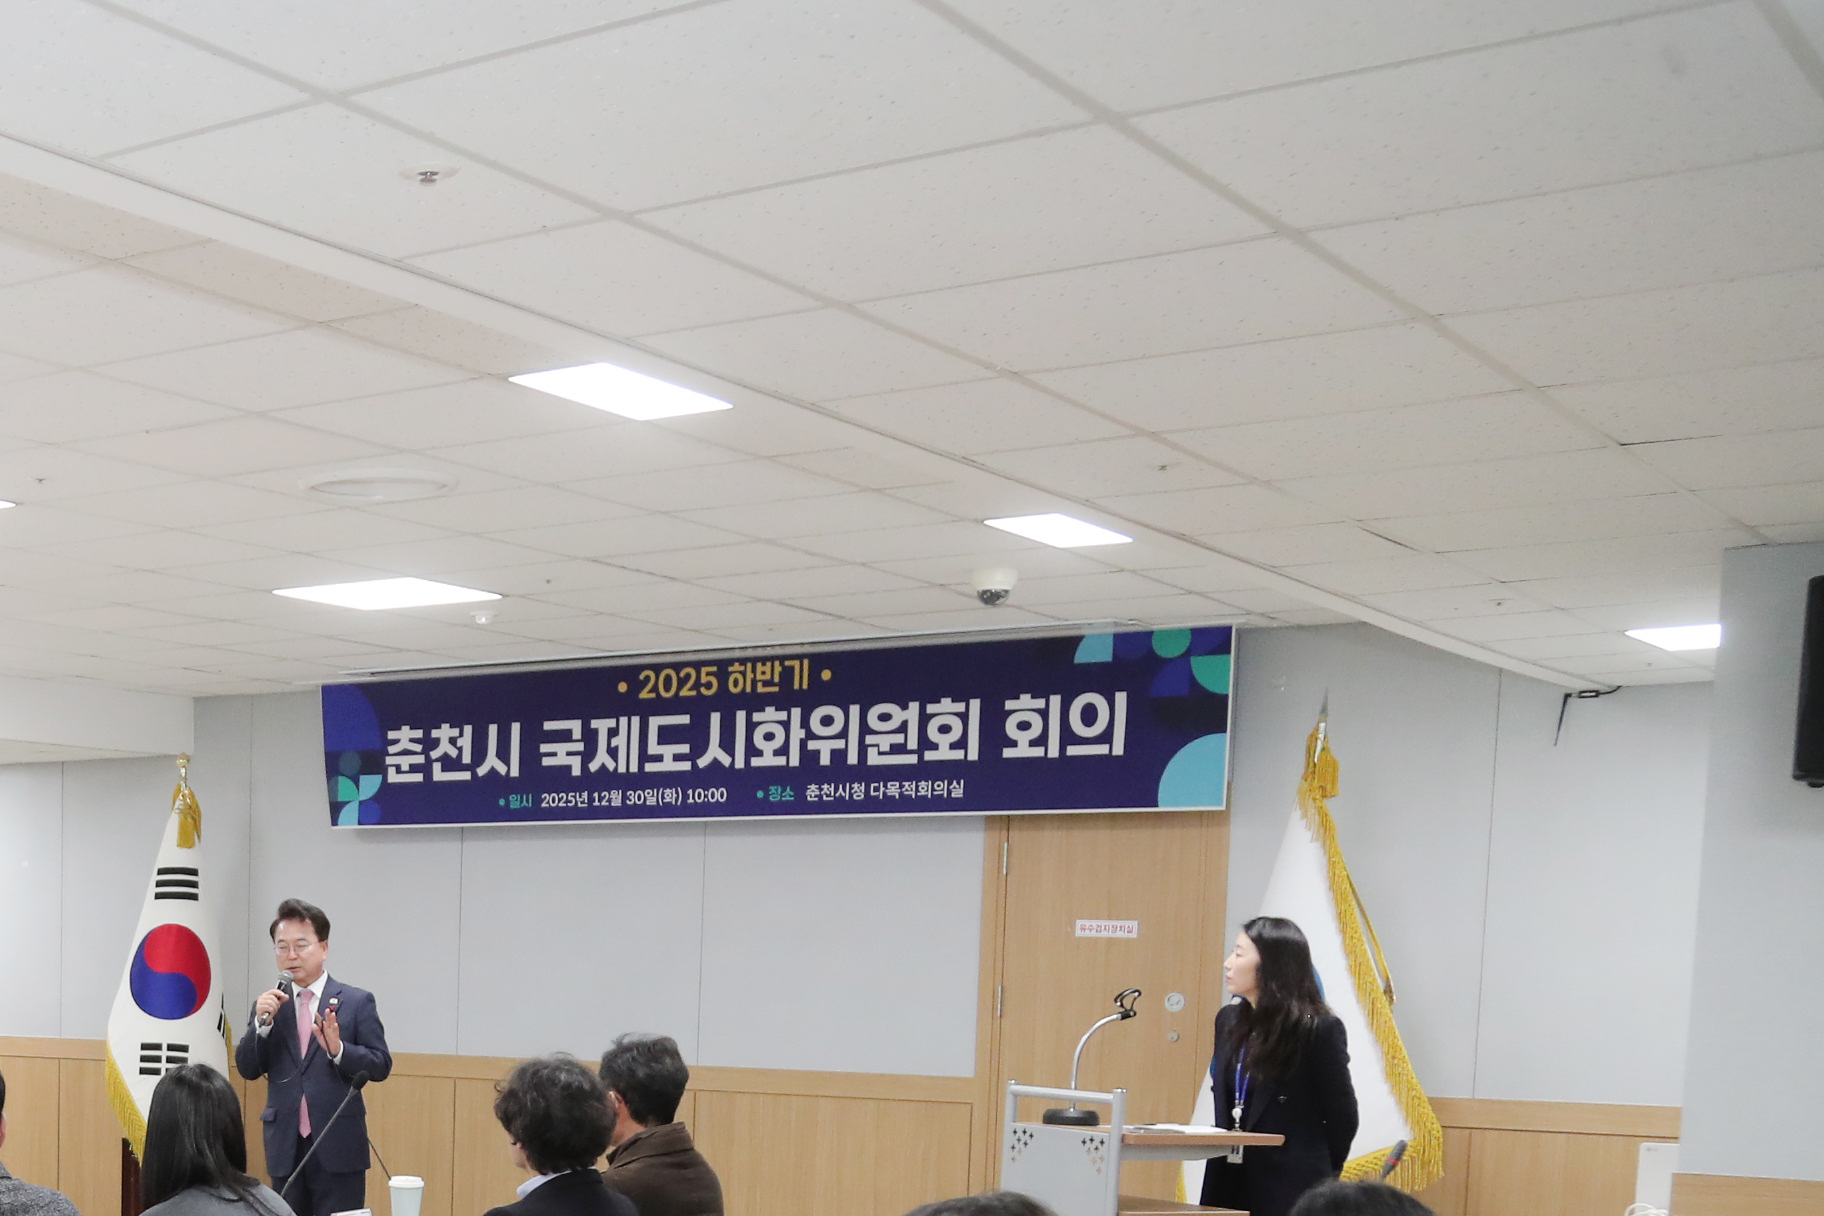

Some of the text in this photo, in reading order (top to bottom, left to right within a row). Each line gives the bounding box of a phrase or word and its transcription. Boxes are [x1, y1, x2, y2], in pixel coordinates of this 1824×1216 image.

[638, 659, 809, 699] 2025 하반기
[384, 691, 1127, 784] 춘천시 국제도시화위원회 회의
[509, 779, 964, 808] 일시 2025년 12월 30일(화) 10:00 장소 춘천시청 다목적회의실
[1080, 923, 1134, 934] 유수검지장치실
